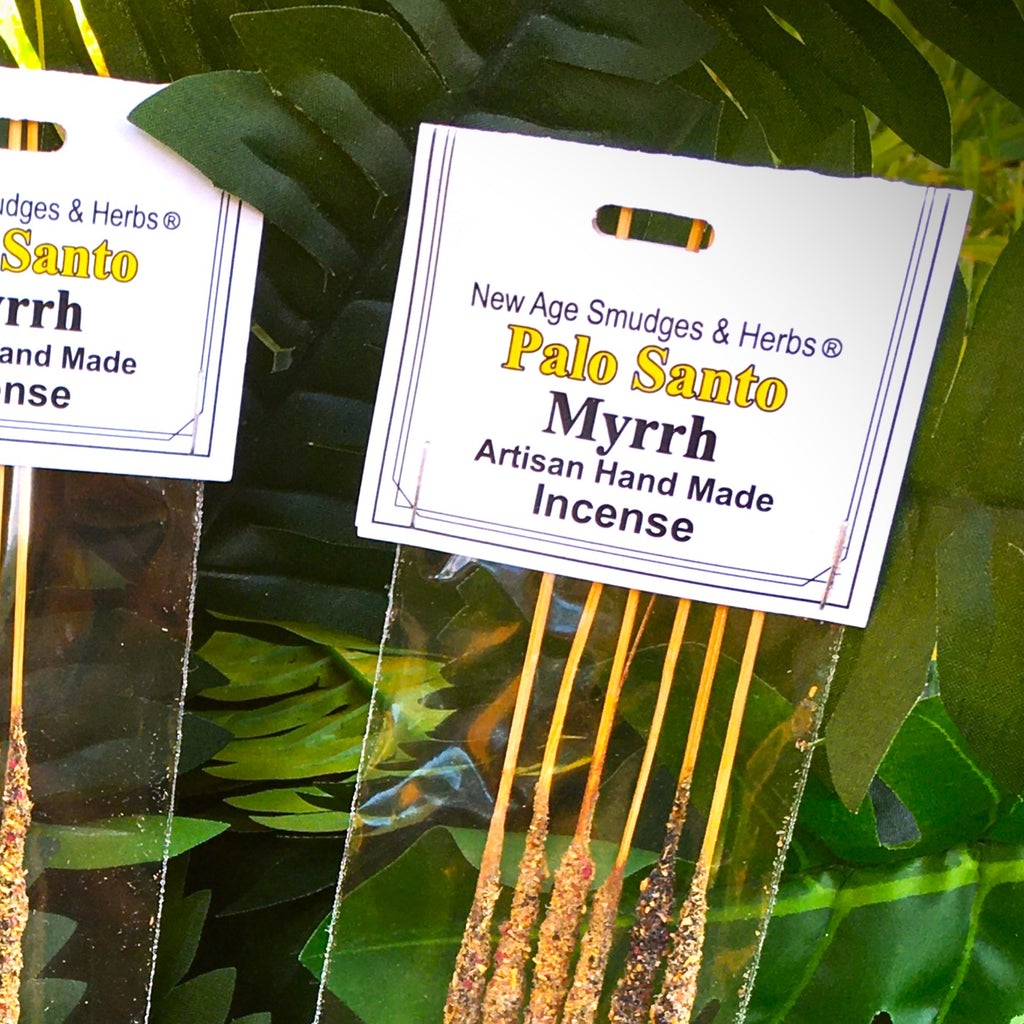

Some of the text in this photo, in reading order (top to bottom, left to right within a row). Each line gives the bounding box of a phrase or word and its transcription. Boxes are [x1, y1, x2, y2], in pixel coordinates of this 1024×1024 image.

[68, 198, 84, 223] &
[0, 227, 139, 284] Santo
[471, 281, 526, 314] New
[528, 291, 579, 326] Age
[587, 298, 704, 343] Smudges
[712, 317, 730, 345] &
[61, 345, 137, 375] Made
[500, 323, 789, 413] Palo Santo
[541, 390, 717, 463] Myrrh
[473, 438, 774, 513] Artisan Hand Made
[531, 483, 694, 543] Incense
